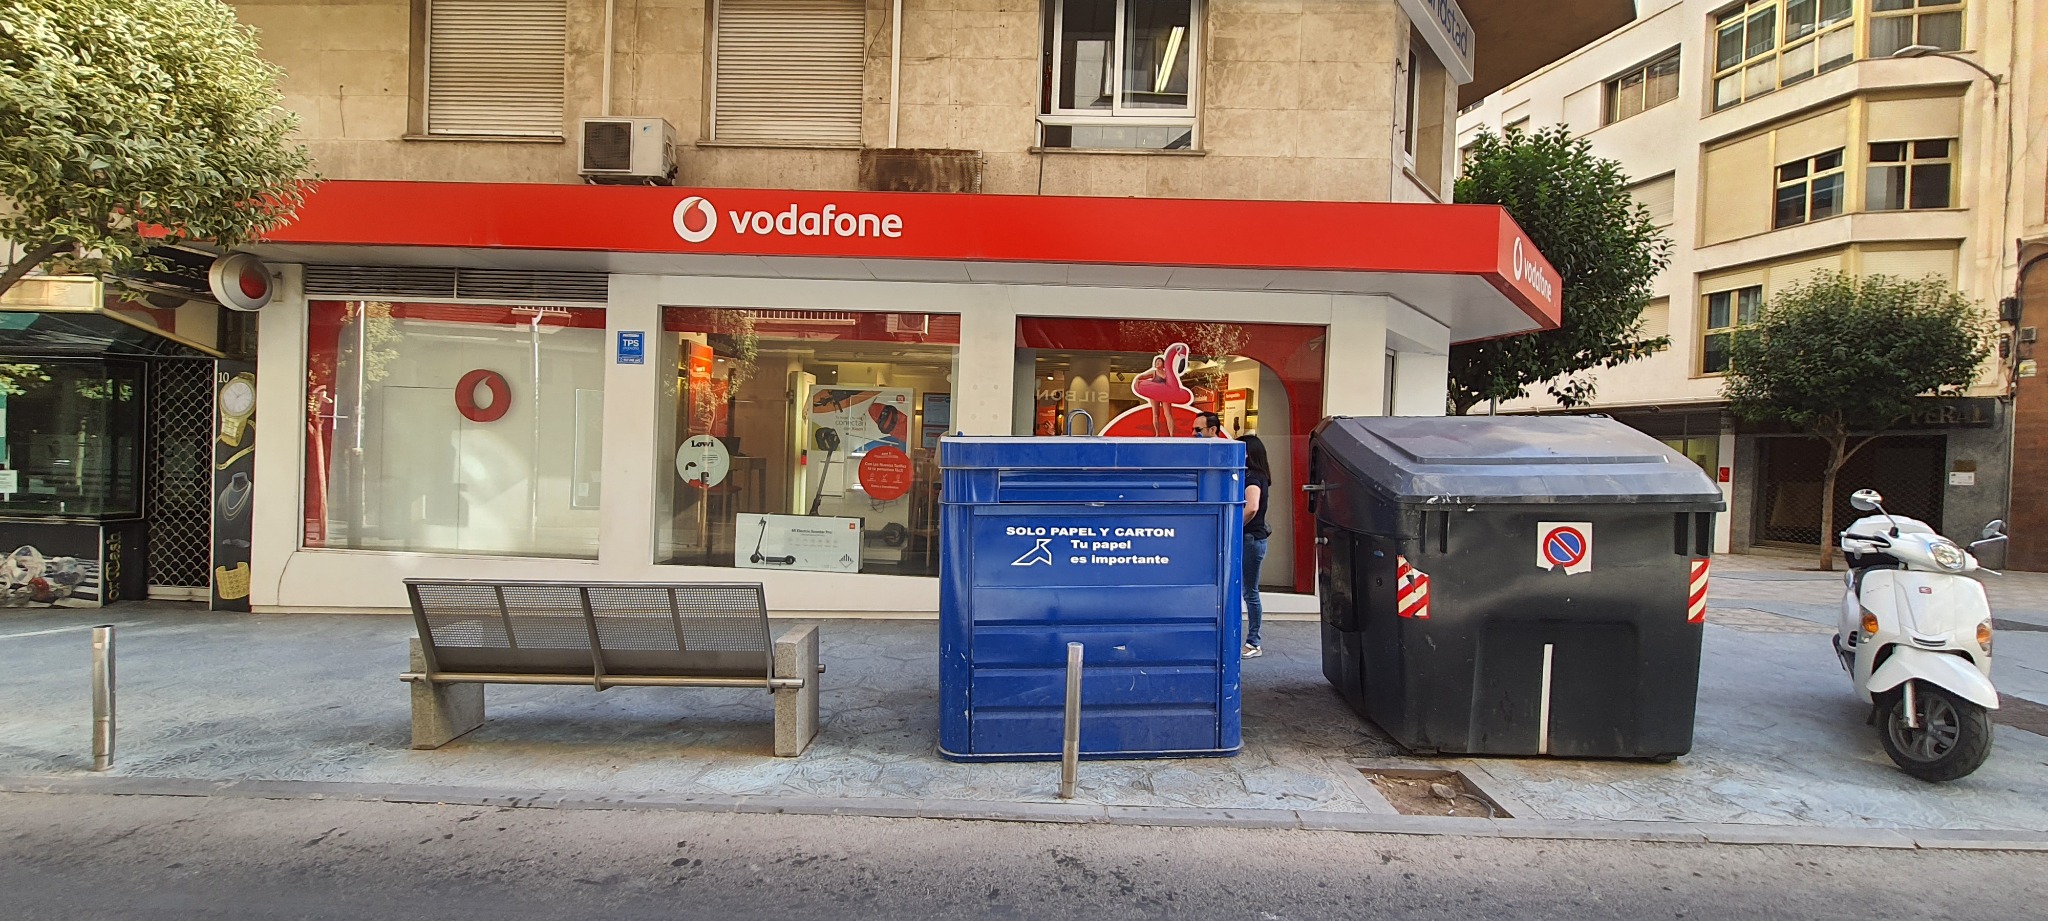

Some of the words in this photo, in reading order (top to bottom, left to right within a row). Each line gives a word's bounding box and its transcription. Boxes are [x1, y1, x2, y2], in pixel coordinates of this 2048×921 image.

[729, 204, 903, 238] vodafone
[1524, 257, 1552, 303] vodafone
[622, 339, 640, 347] TPS
[218, 372, 230, 383] 10
[691, 440, 714, 448] Lowi
[1006, 526, 1046, 536] SOLO
[1050, 527, 1096, 537] PAPEL
[1099, 527, 1110, 537] Y
[1114, 527, 1175, 537] CARTON
[1070, 539, 1088, 549] Tu
[1092, 539, 1132, 551] papel
[1070, 556, 1087, 564] es
[1091, 554, 1169, 566] importante
